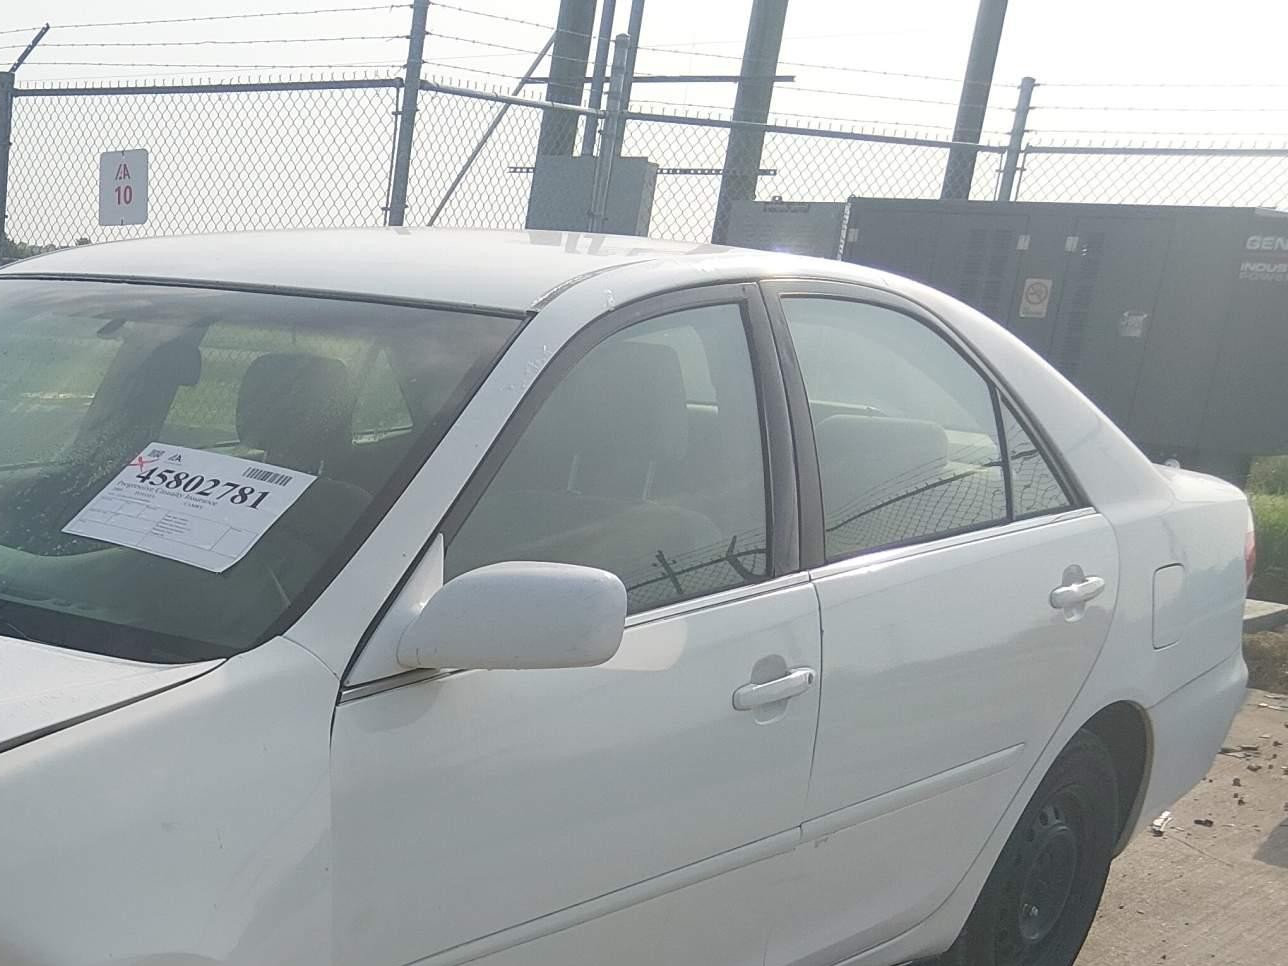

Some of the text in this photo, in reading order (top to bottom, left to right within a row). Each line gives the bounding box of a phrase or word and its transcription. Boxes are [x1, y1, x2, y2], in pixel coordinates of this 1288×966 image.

[115, 185, 132, 205] 10
[1246, 235, 1288, 250] GEN
[117, 480, 155, 493] Progressive
[136, 466, 271, 511] 45802781
